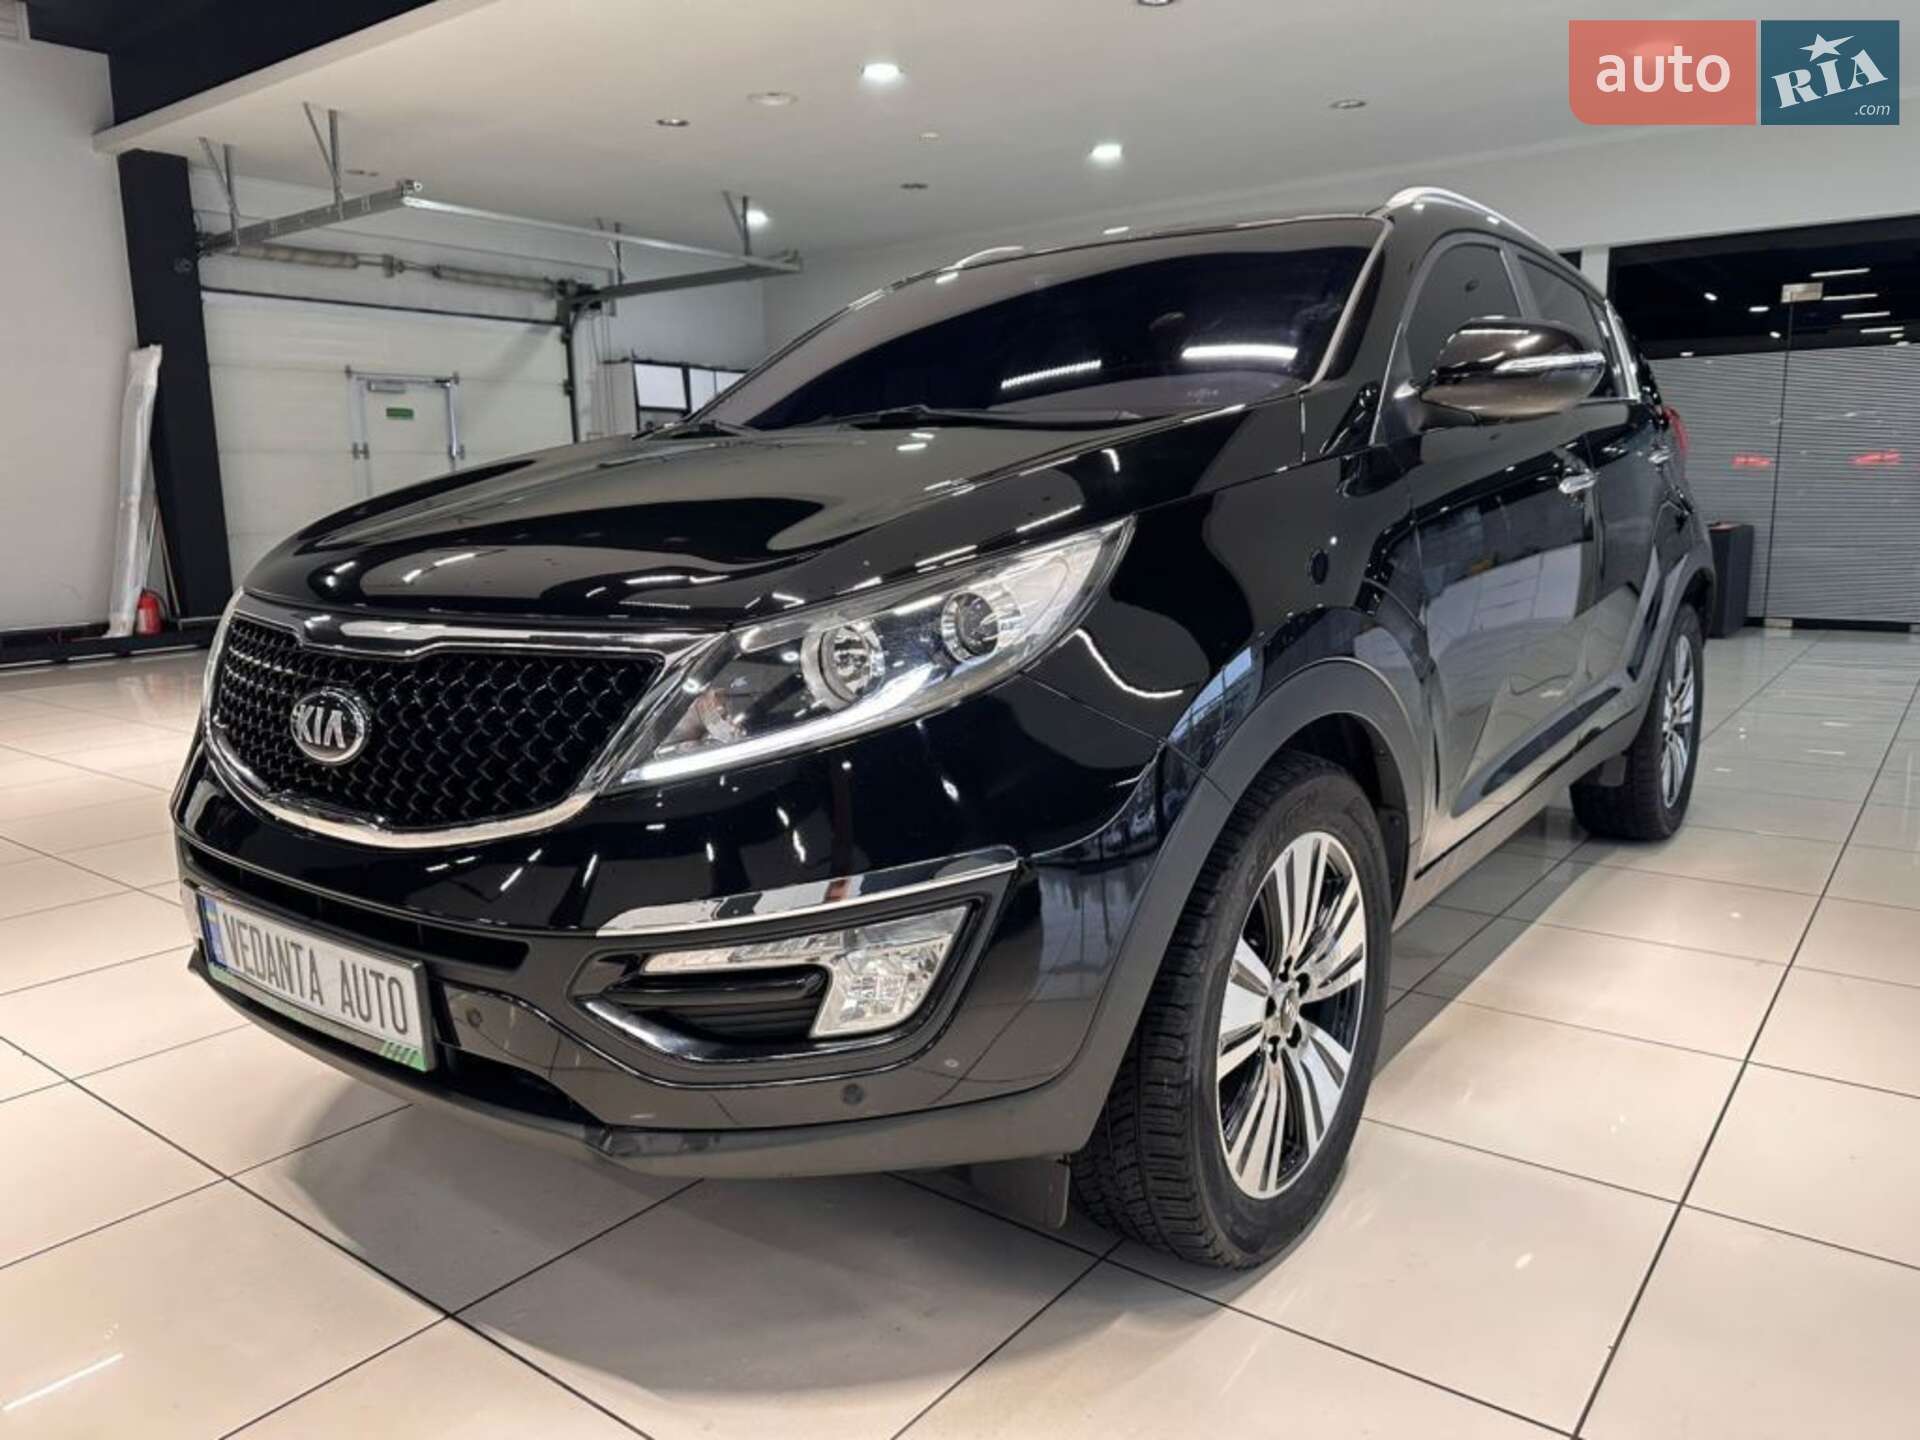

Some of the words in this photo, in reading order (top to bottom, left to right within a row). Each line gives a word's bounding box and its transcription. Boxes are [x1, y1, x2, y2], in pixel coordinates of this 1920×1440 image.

[296, 704, 347, 749] KIA
[223, 912, 325, 1006] VEDANTA
[339, 958, 409, 1036] AUTO
